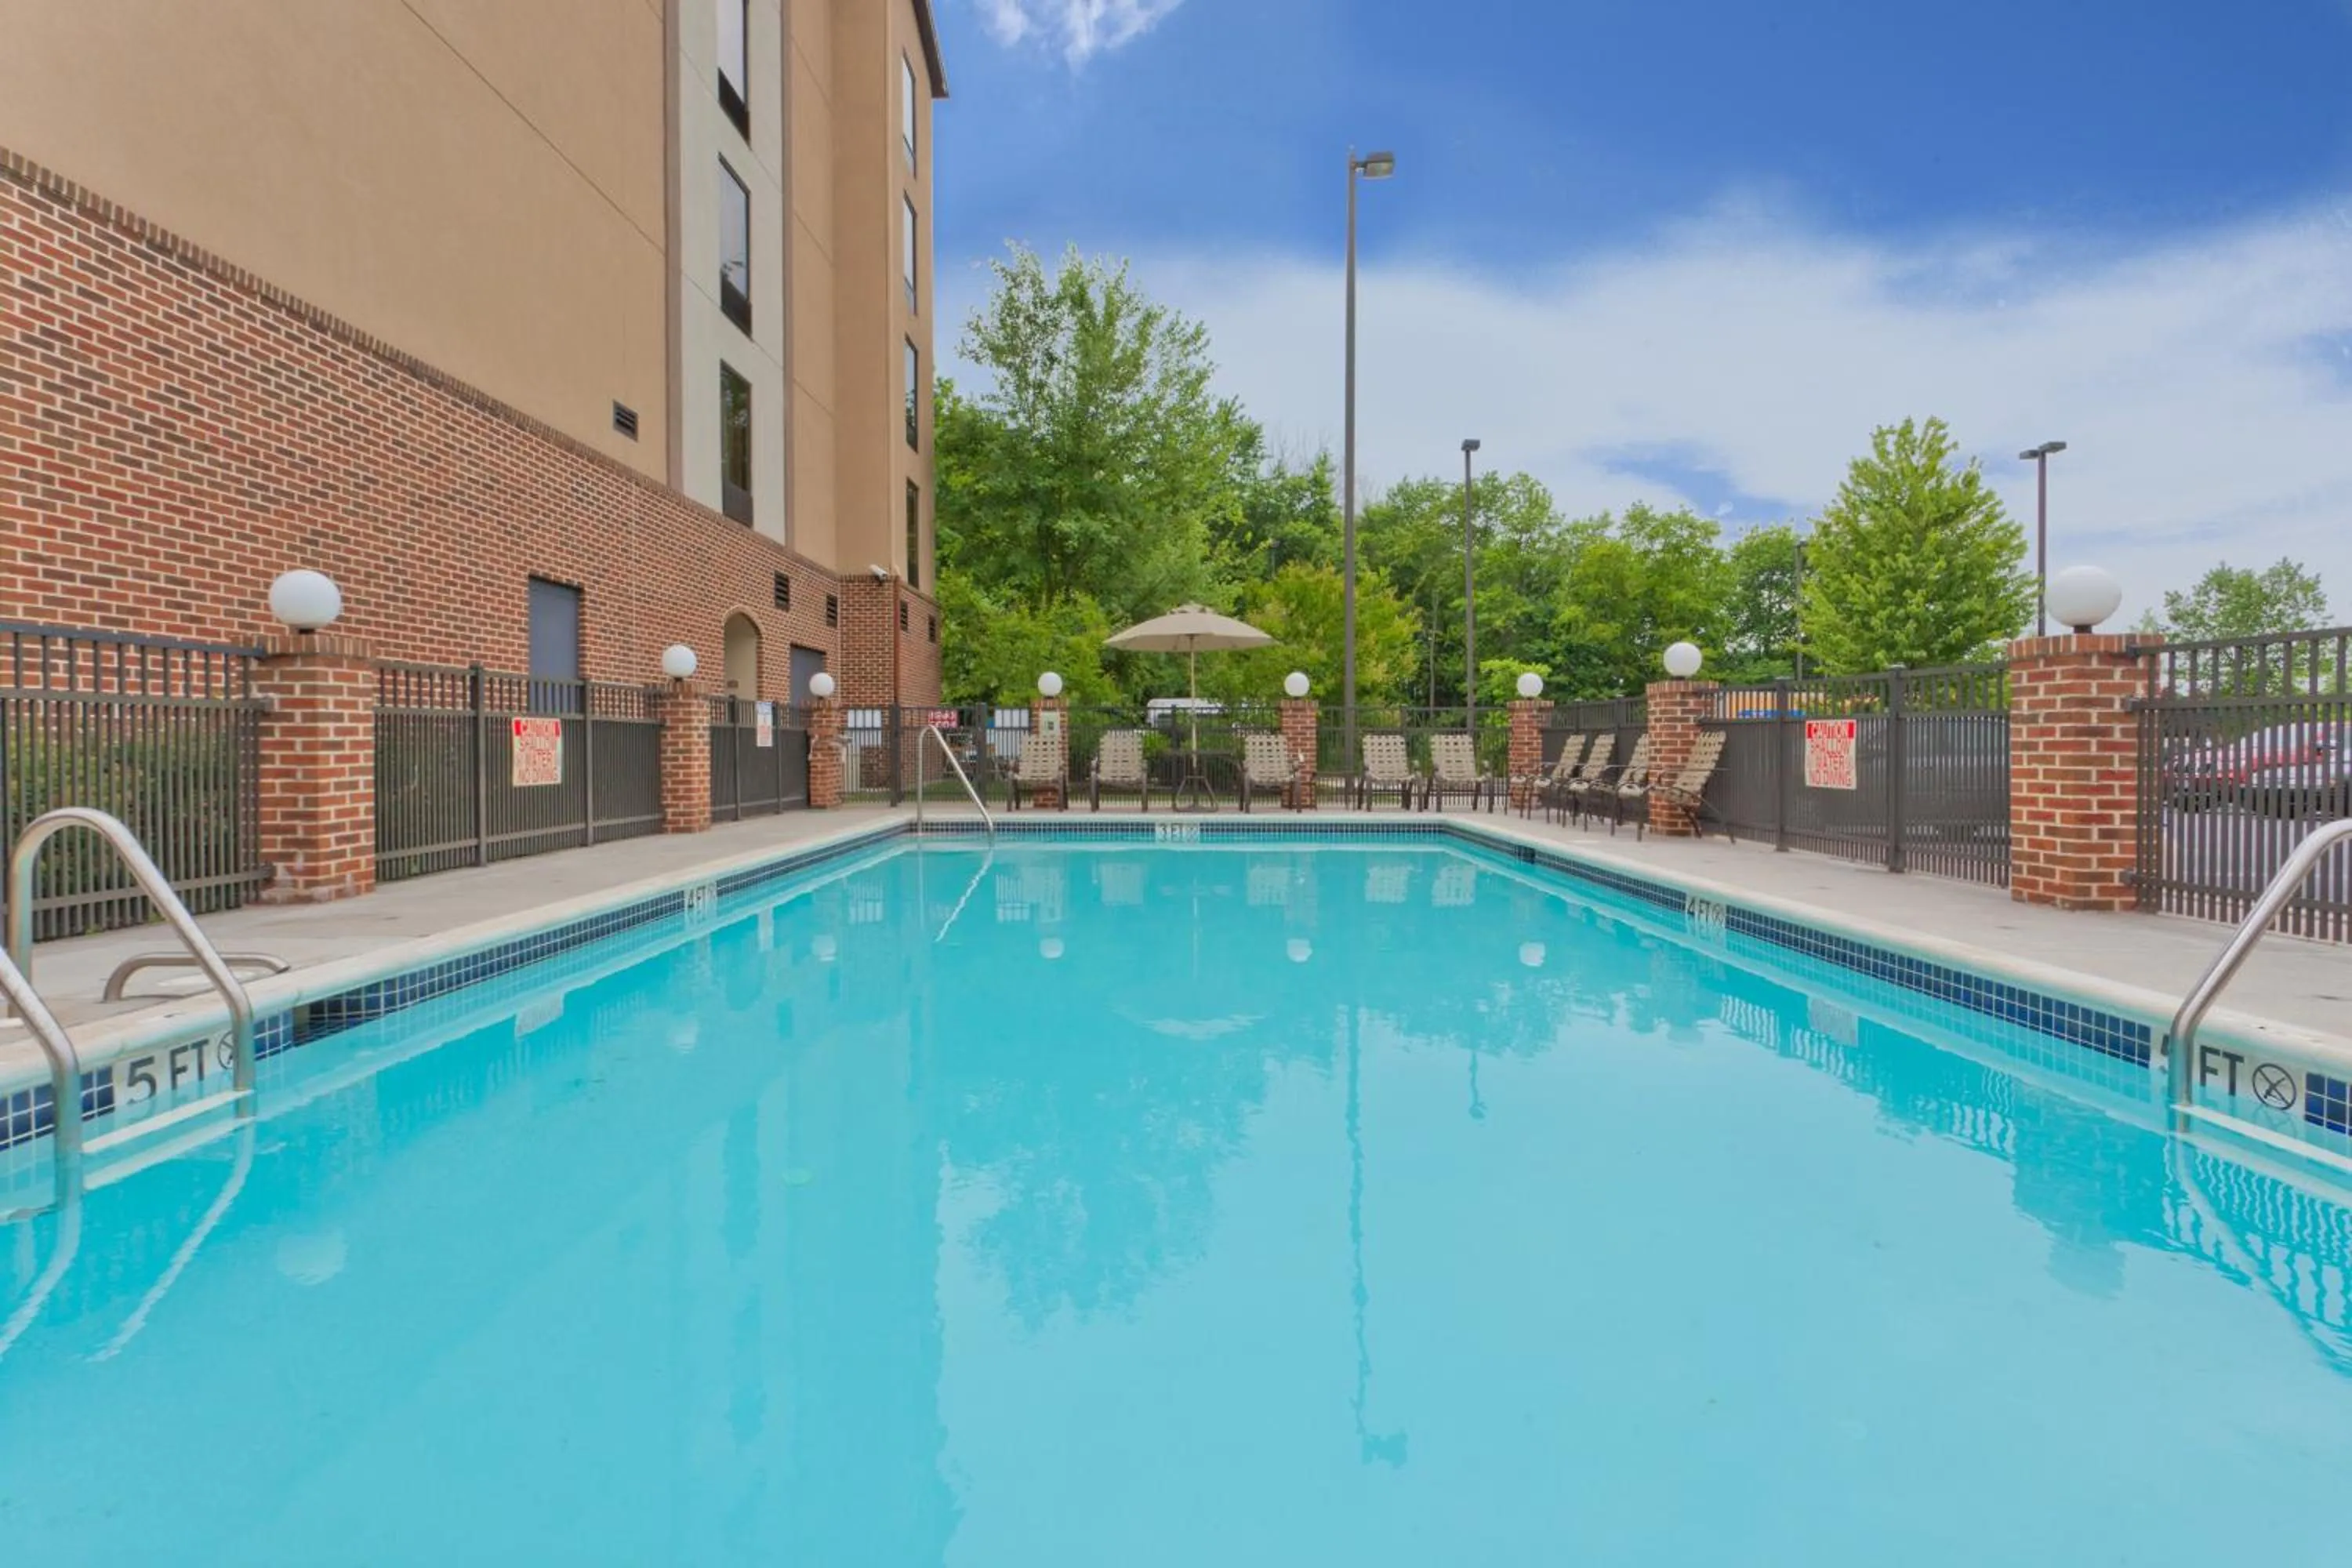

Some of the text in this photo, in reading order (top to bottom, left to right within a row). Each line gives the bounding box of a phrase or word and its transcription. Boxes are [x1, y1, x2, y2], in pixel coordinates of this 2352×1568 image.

[1812, 722, 1847, 739] CAUTION
[1809, 739, 1850, 754] SHALLOW
[1809, 769, 1853, 787] NO DIVING
[1687, 897, 1711, 923] 4 FT
[127, 1038, 209, 1105] 5 FT
[2199, 1044, 2245, 1096] FT
